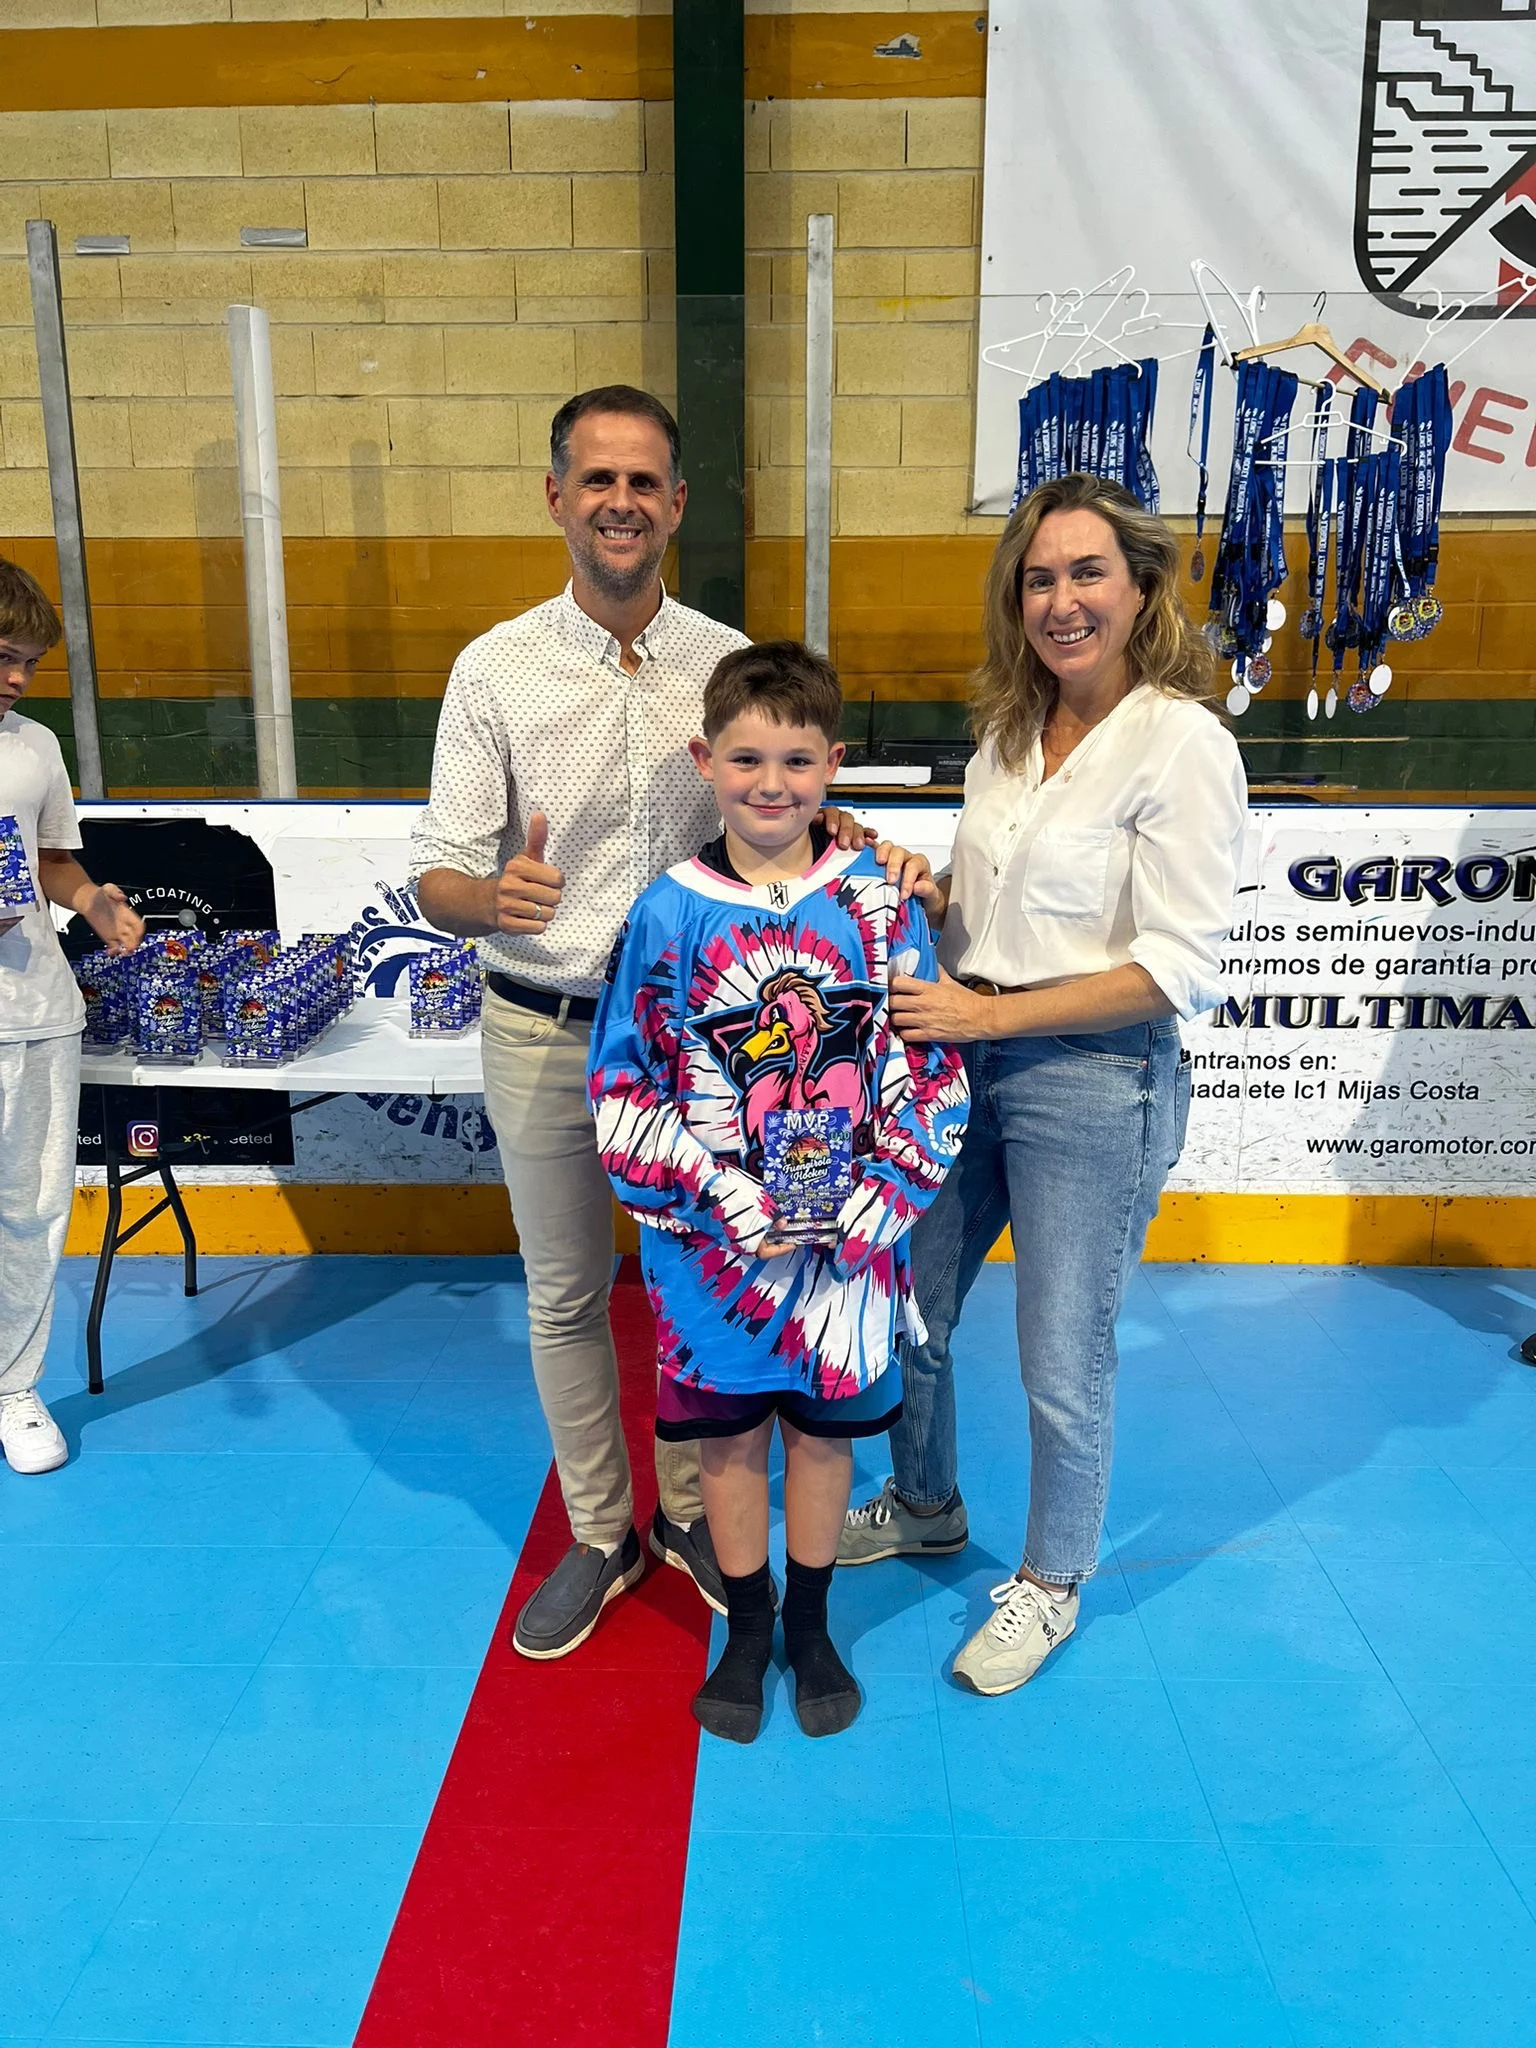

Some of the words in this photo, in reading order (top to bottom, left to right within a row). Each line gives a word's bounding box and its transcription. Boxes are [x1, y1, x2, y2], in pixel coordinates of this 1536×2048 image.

[146, 888, 212, 914] COATING
[1223, 920, 1285, 941] ulos
[1331, 953, 1364, 975] de
[1375, 953, 1490, 980] garantía
[1194, 1051, 1290, 1070] ntramos
[1300, 1055, 1336, 1070] en:
[1338, 1080, 1400, 1104] Mijas
[1409, 1080, 1480, 1100] Costa
[786, 1113, 829, 1130] MVP
[1306, 1135, 1536, 1158] www.garomotor.co
[782, 1156, 833, 1173] Fuengirola
[792, 1168, 829, 1182] Hockey
